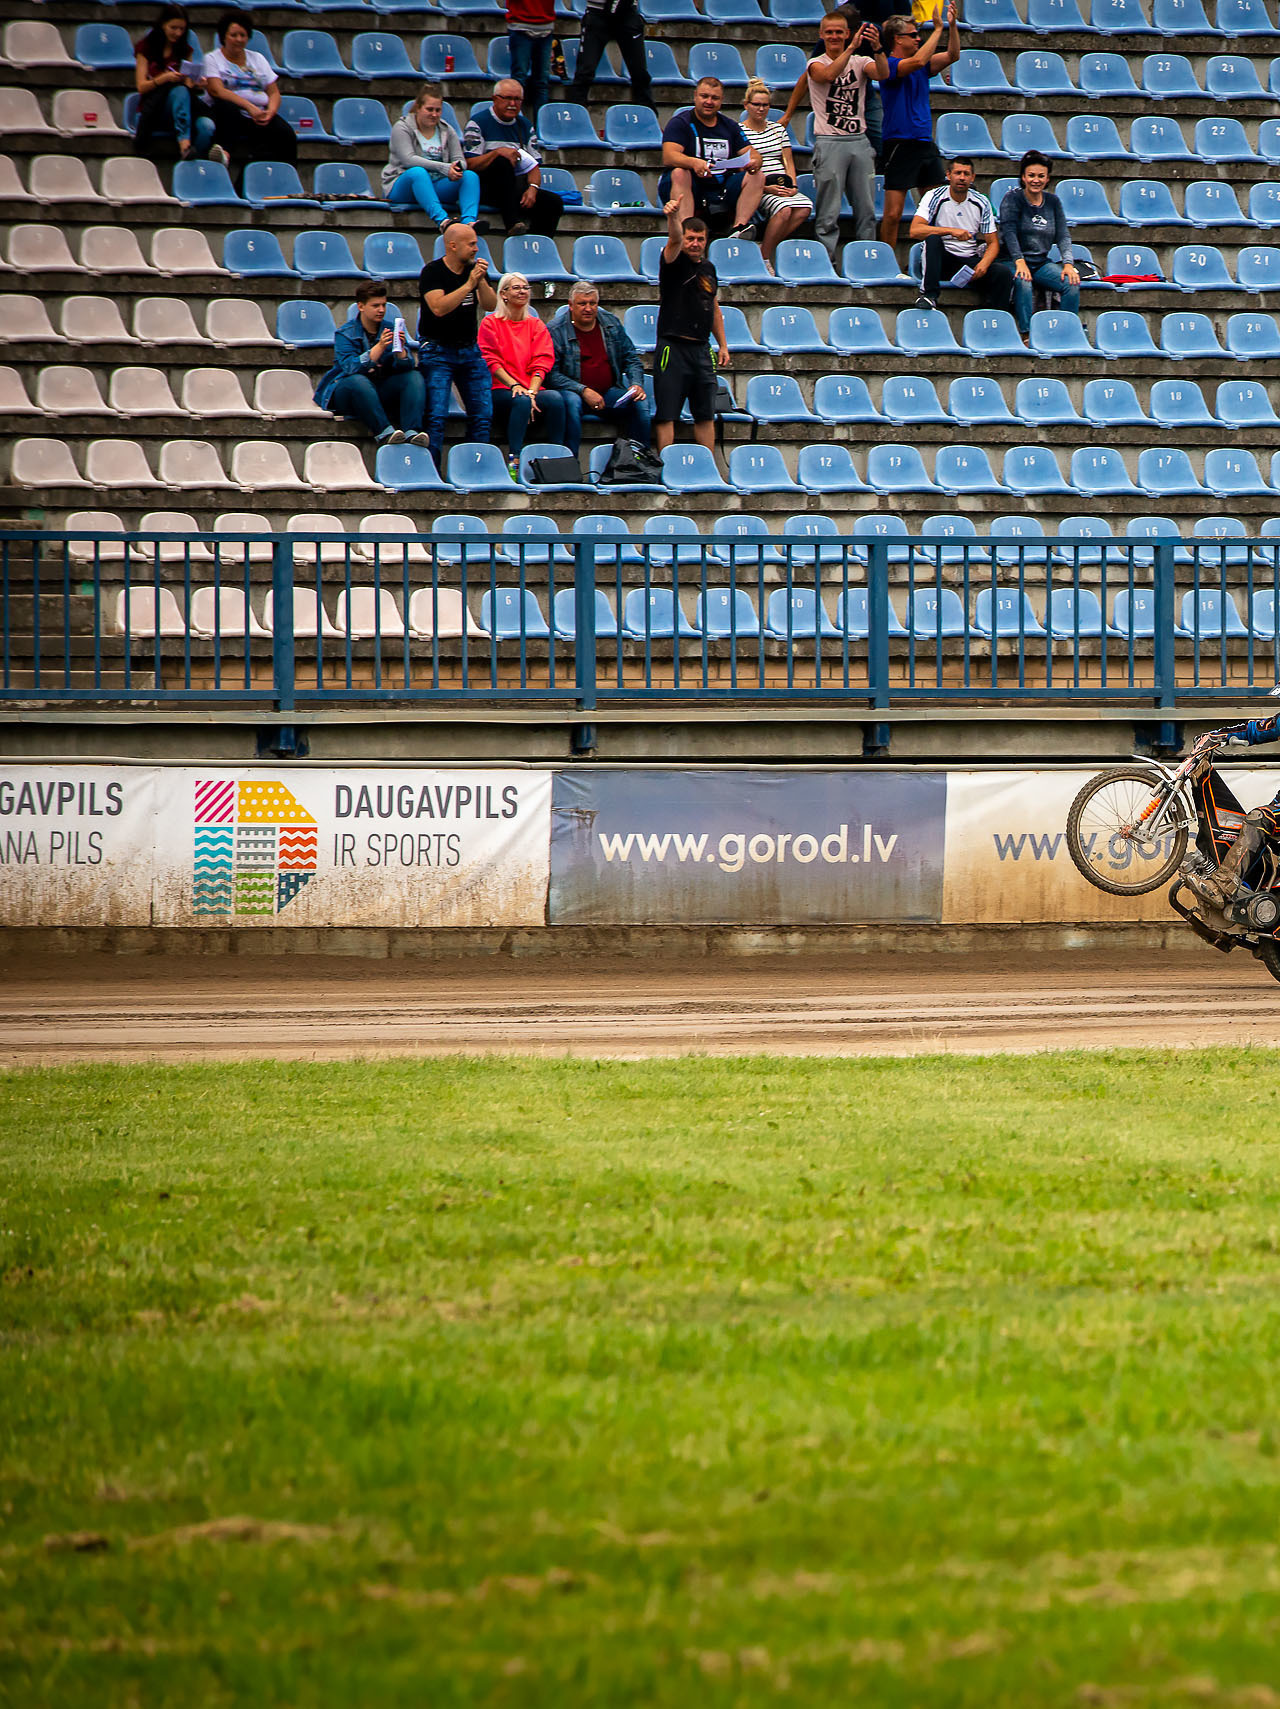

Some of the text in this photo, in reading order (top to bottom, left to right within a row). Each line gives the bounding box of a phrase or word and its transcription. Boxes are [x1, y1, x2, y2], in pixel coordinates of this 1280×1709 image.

[834, 115, 858, 133] TYO
[247, 240, 255, 252] 6
[319, 241, 327, 251] 7
[386, 240, 394, 254] 8
[523, 240, 540, 254] 10
[594, 244, 605, 255] 11
[727, 246, 739, 259] 13
[795, 247, 811, 259] 14
[864, 248, 878, 260] 15
[1126, 254, 1142, 267] 19
[1189, 252, 1207, 267] 20
[1253, 254, 1269, 266] 21
[769, 385, 782, 396] 12
[837, 384, 851, 396] 13
[971, 386, 985, 397] 15
[1037, 387, 1049, 398] 16
[1103, 388, 1115, 399] 17
[1170, 391, 1182, 401] 18
[1239, 389, 1253, 402] 19
[404, 455, 411, 466] 6
[475, 452, 482, 463] 7
[750, 457, 765, 467] 11
[820, 456, 832, 467] 12
[889, 456, 902, 467] 13
[1023, 455, 1036, 466] 15
[1092, 455, 1107, 467] 16
[1158, 455, 1173, 468] 17
[1226, 460, 1241, 473] 18
[0, 781, 123, 816] GAVPILS
[335, 785, 519, 819] DAUGAVPILS
[49, 830, 104, 865] PILS
[333, 833, 461, 867] IR SPORTS
[598, 824, 899, 873] www.gorod.lv
